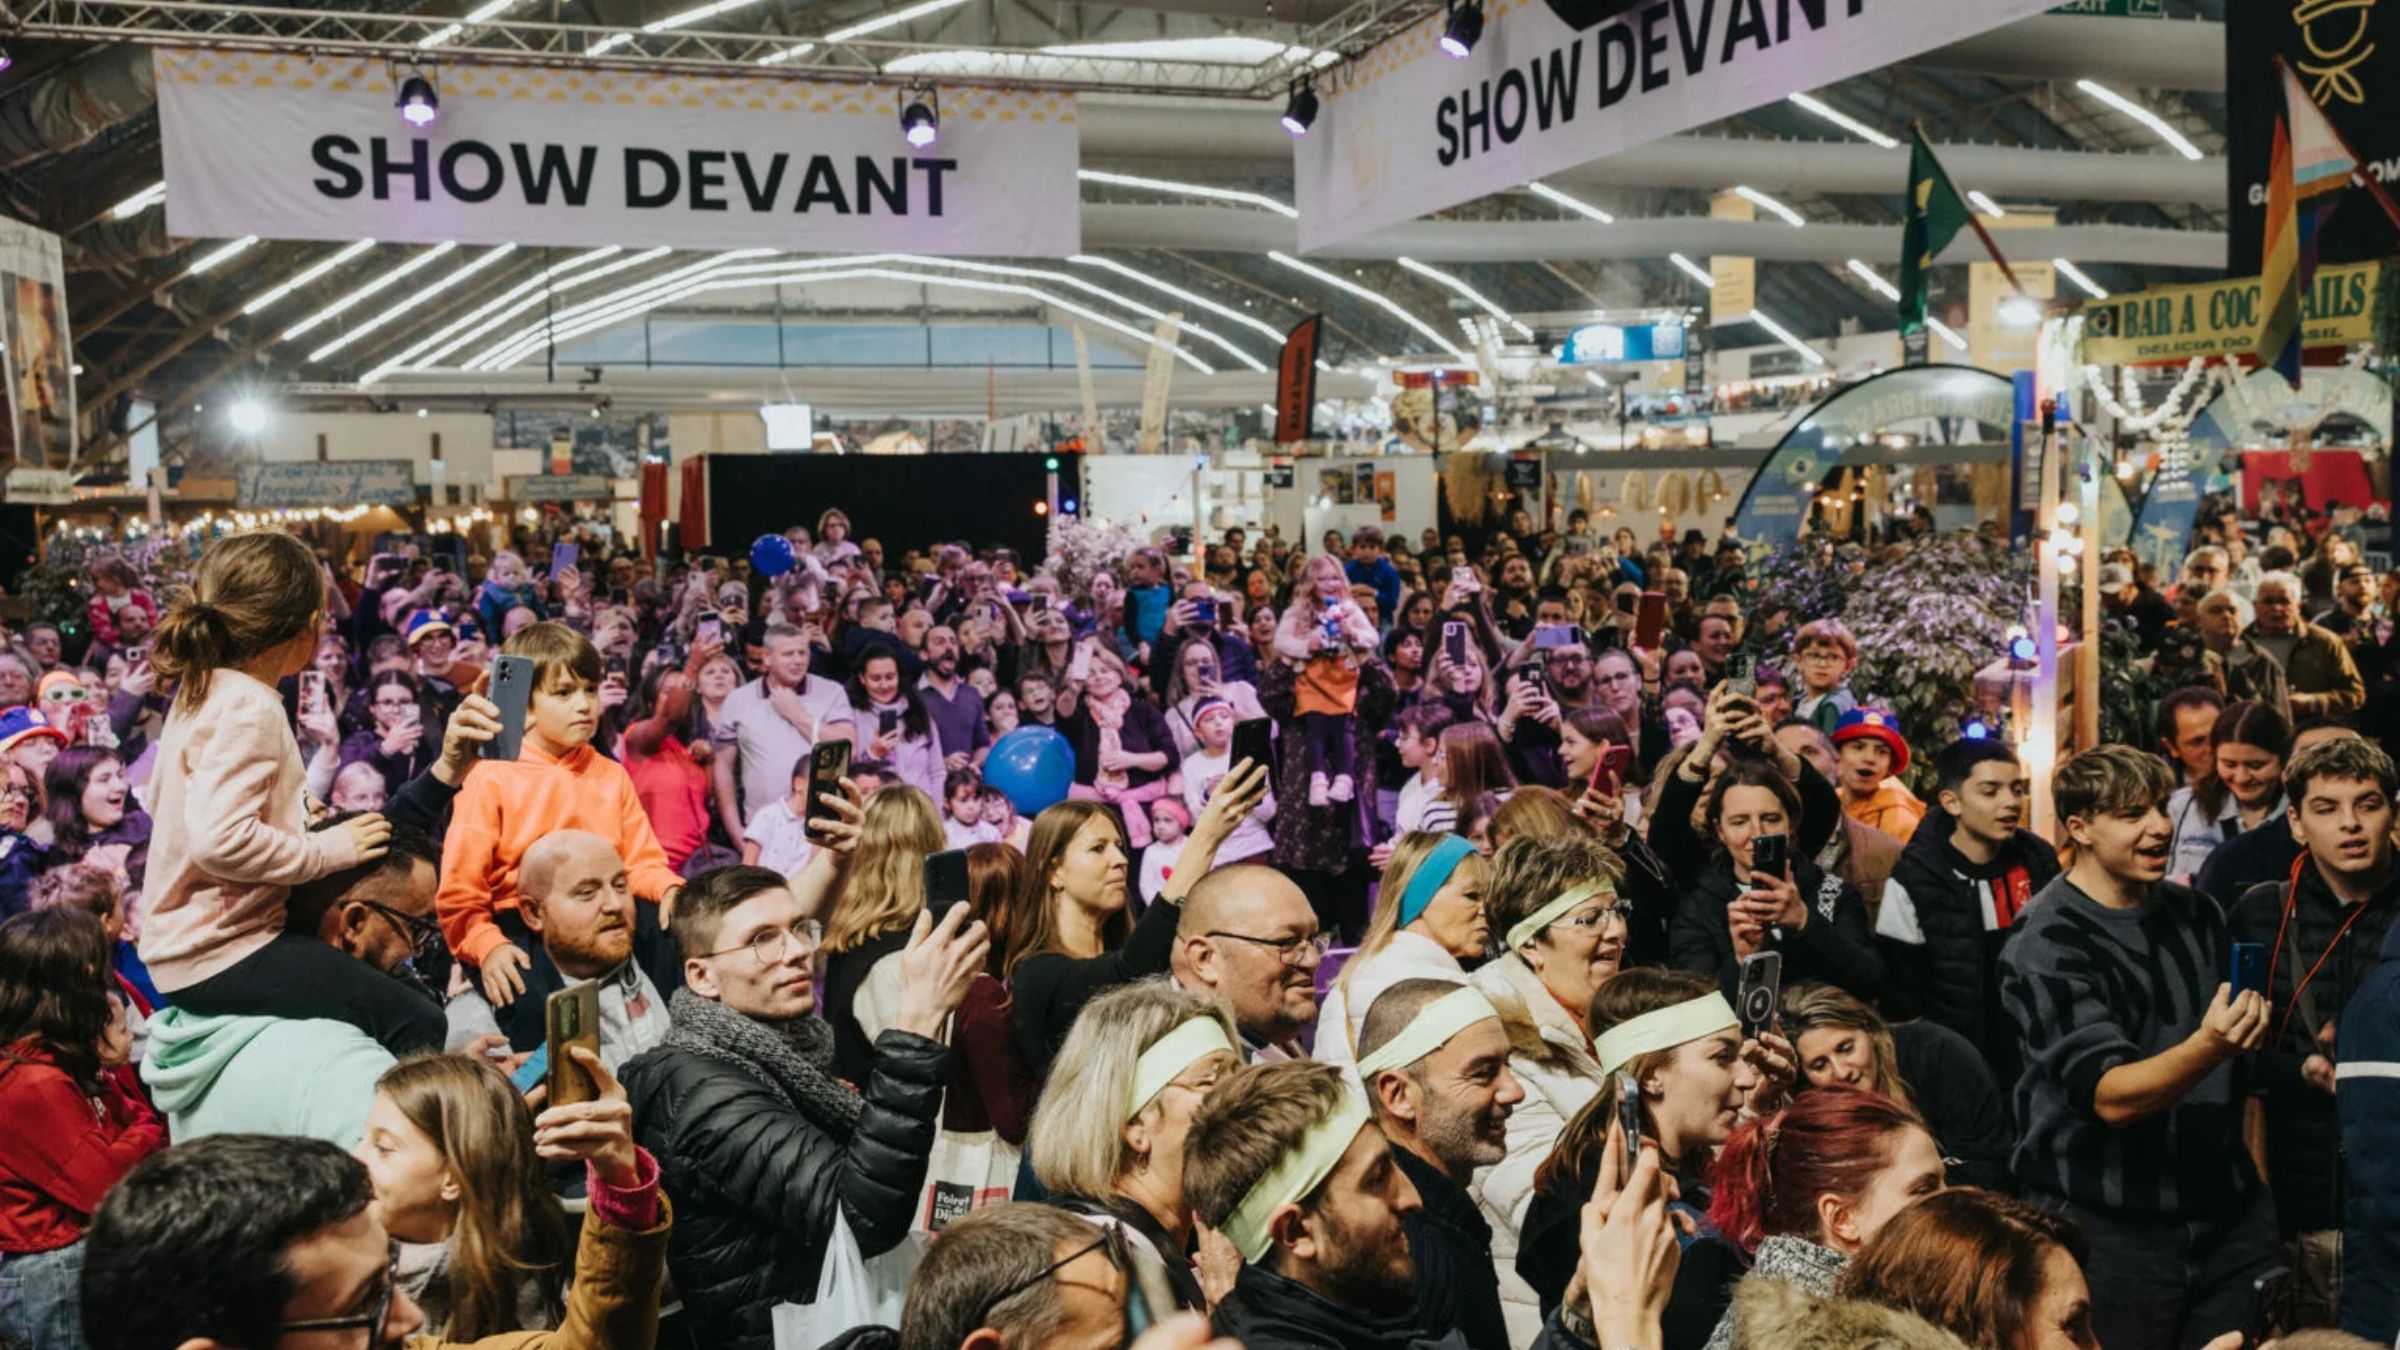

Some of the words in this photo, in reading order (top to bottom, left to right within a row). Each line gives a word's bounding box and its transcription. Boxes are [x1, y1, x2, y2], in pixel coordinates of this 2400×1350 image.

[1437, 40, 1582, 167] SHOW
[311, 135, 598, 207] SHOW
[624, 147, 958, 217] DEVANT
[2123, 296, 2173, 339] BAR
[2209, 271, 2366, 331] COCAILS
